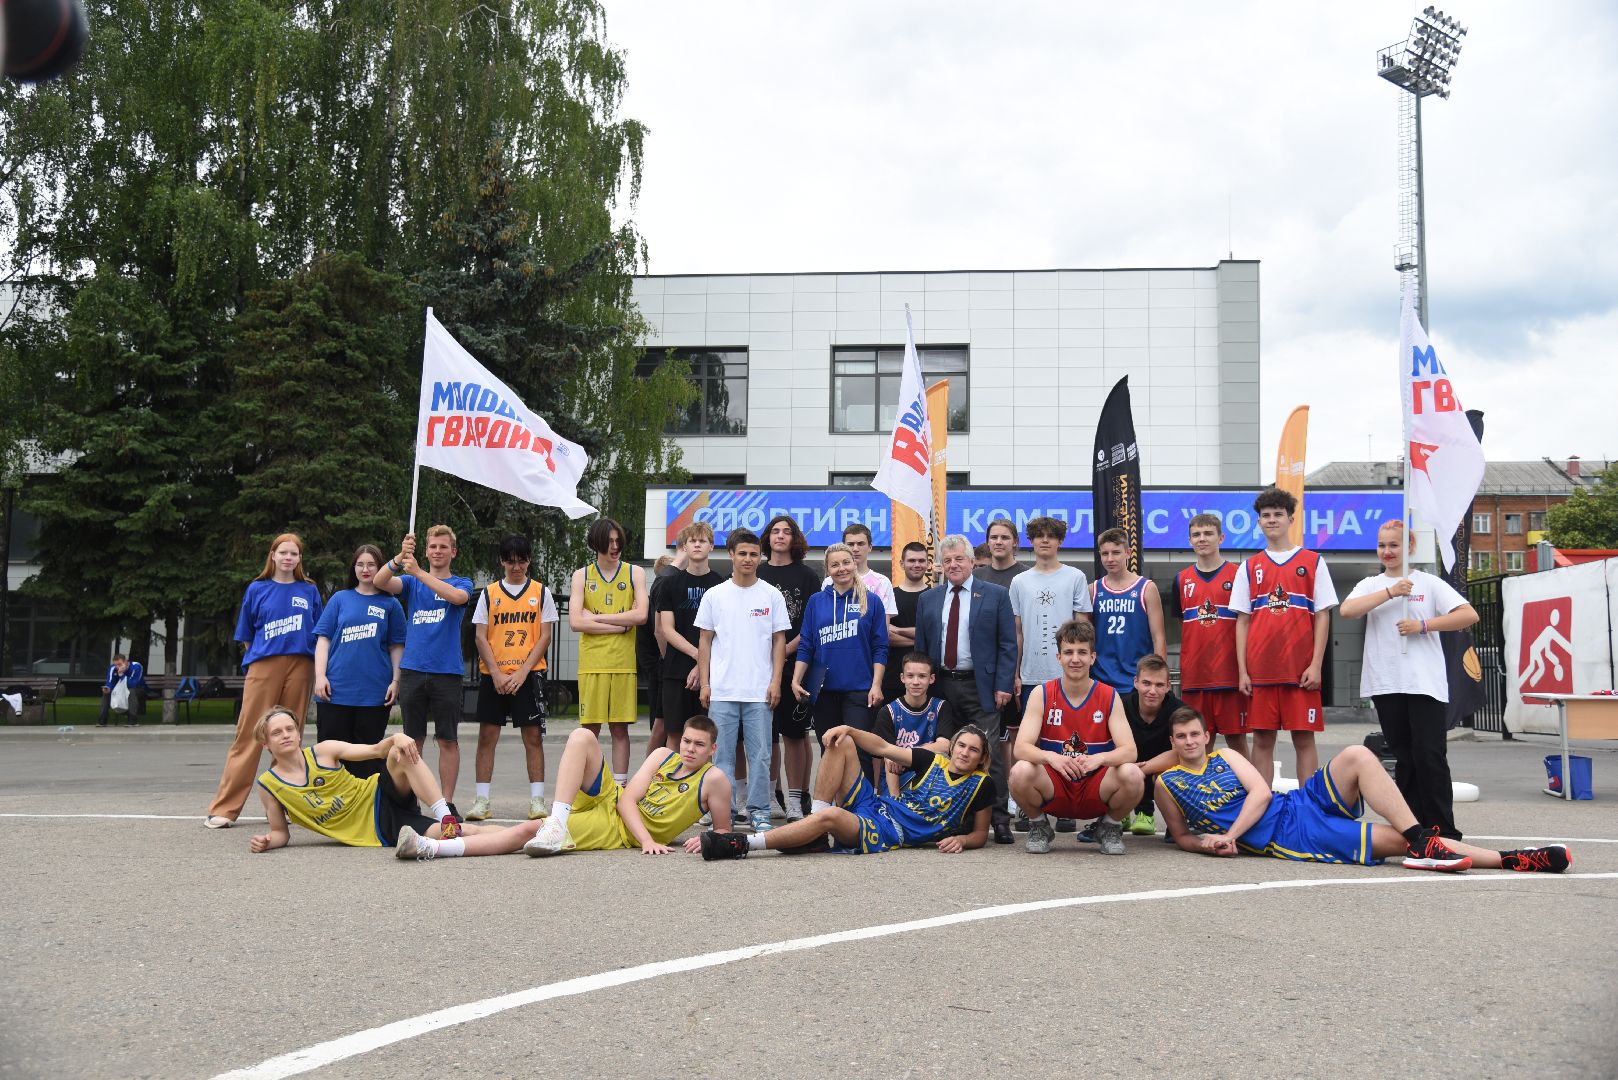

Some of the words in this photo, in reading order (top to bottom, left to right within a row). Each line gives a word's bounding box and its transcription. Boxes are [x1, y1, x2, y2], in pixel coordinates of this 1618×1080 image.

[693, 507, 887, 532] СПОТИВН
[963, 508, 1169, 534] КОМЛС
[1256, 569, 1263, 585] 8
[1184, 583, 1195, 598] 17
[1099, 598, 1136, 613] ХАСКИ
[493, 611, 537, 626] ХИМКИ
[1107, 616, 1126, 634] 22
[504, 629, 528, 648] 27
[1308, 710, 1316, 723] 8
